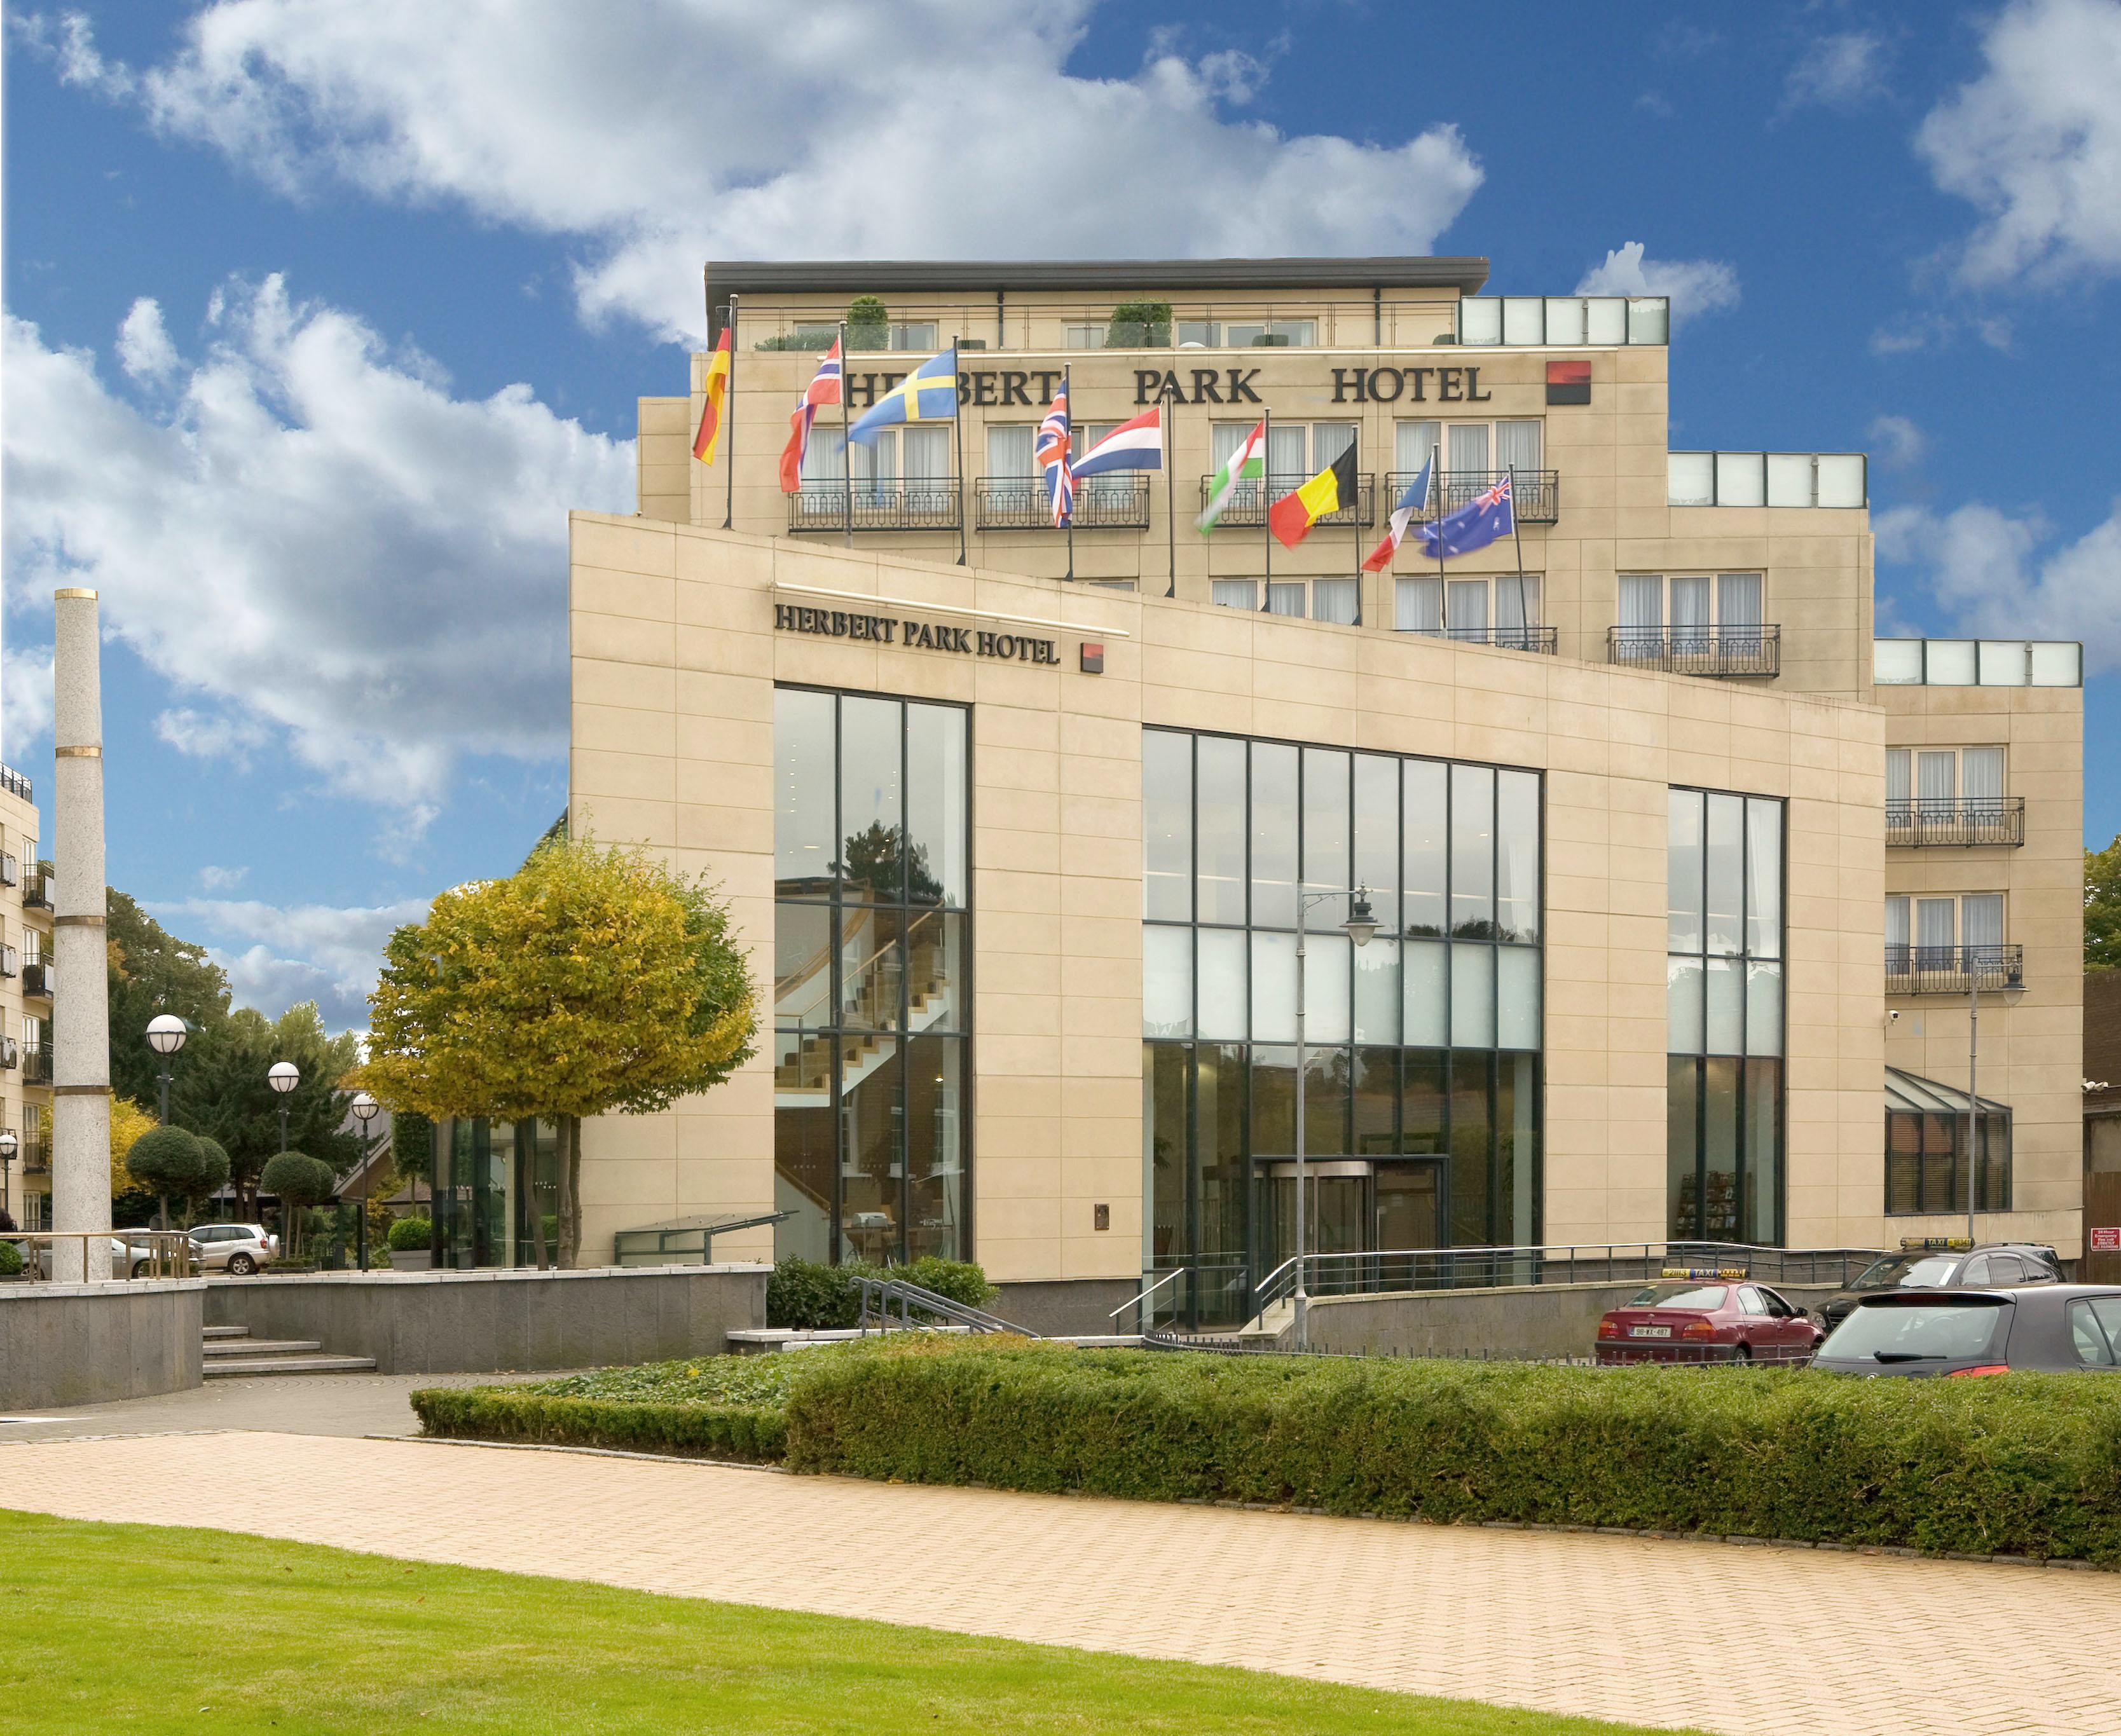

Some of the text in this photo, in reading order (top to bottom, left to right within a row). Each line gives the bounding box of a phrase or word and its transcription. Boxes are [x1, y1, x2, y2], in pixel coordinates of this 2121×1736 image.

[846, 367, 1491, 407] HBERT PARK HOTEL
[774, 603, 1060, 664] HERBERT PARK HOTEL
